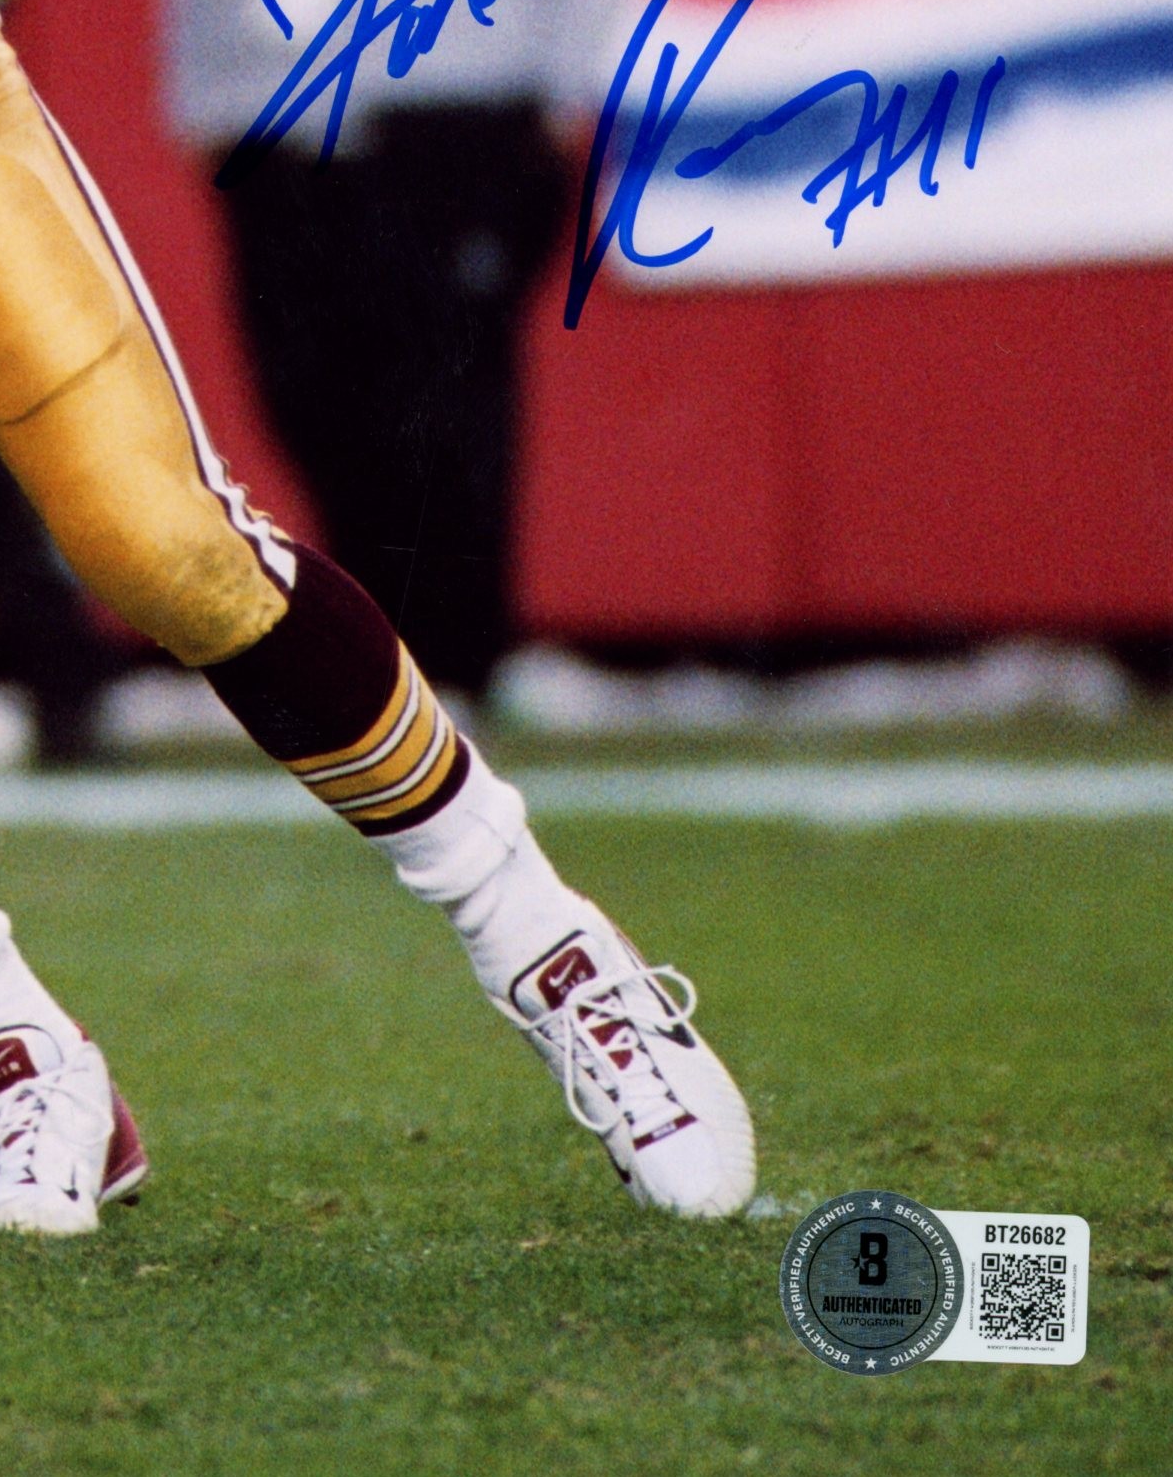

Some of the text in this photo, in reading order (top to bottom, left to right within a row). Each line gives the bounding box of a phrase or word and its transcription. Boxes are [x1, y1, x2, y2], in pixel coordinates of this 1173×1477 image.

[985, 1224, 1066, 1245] BT26682
[790, 1202, 855, 1364] BECKETT VERIFIED AUTHENTIC
[890, 1204, 955, 1366] BECKETT VERIFIED AUTHENTIC
[822, 1295, 922, 1315] AUTHENTICATED
[839, 1316, 904, 1327] AUTOGRAPH
